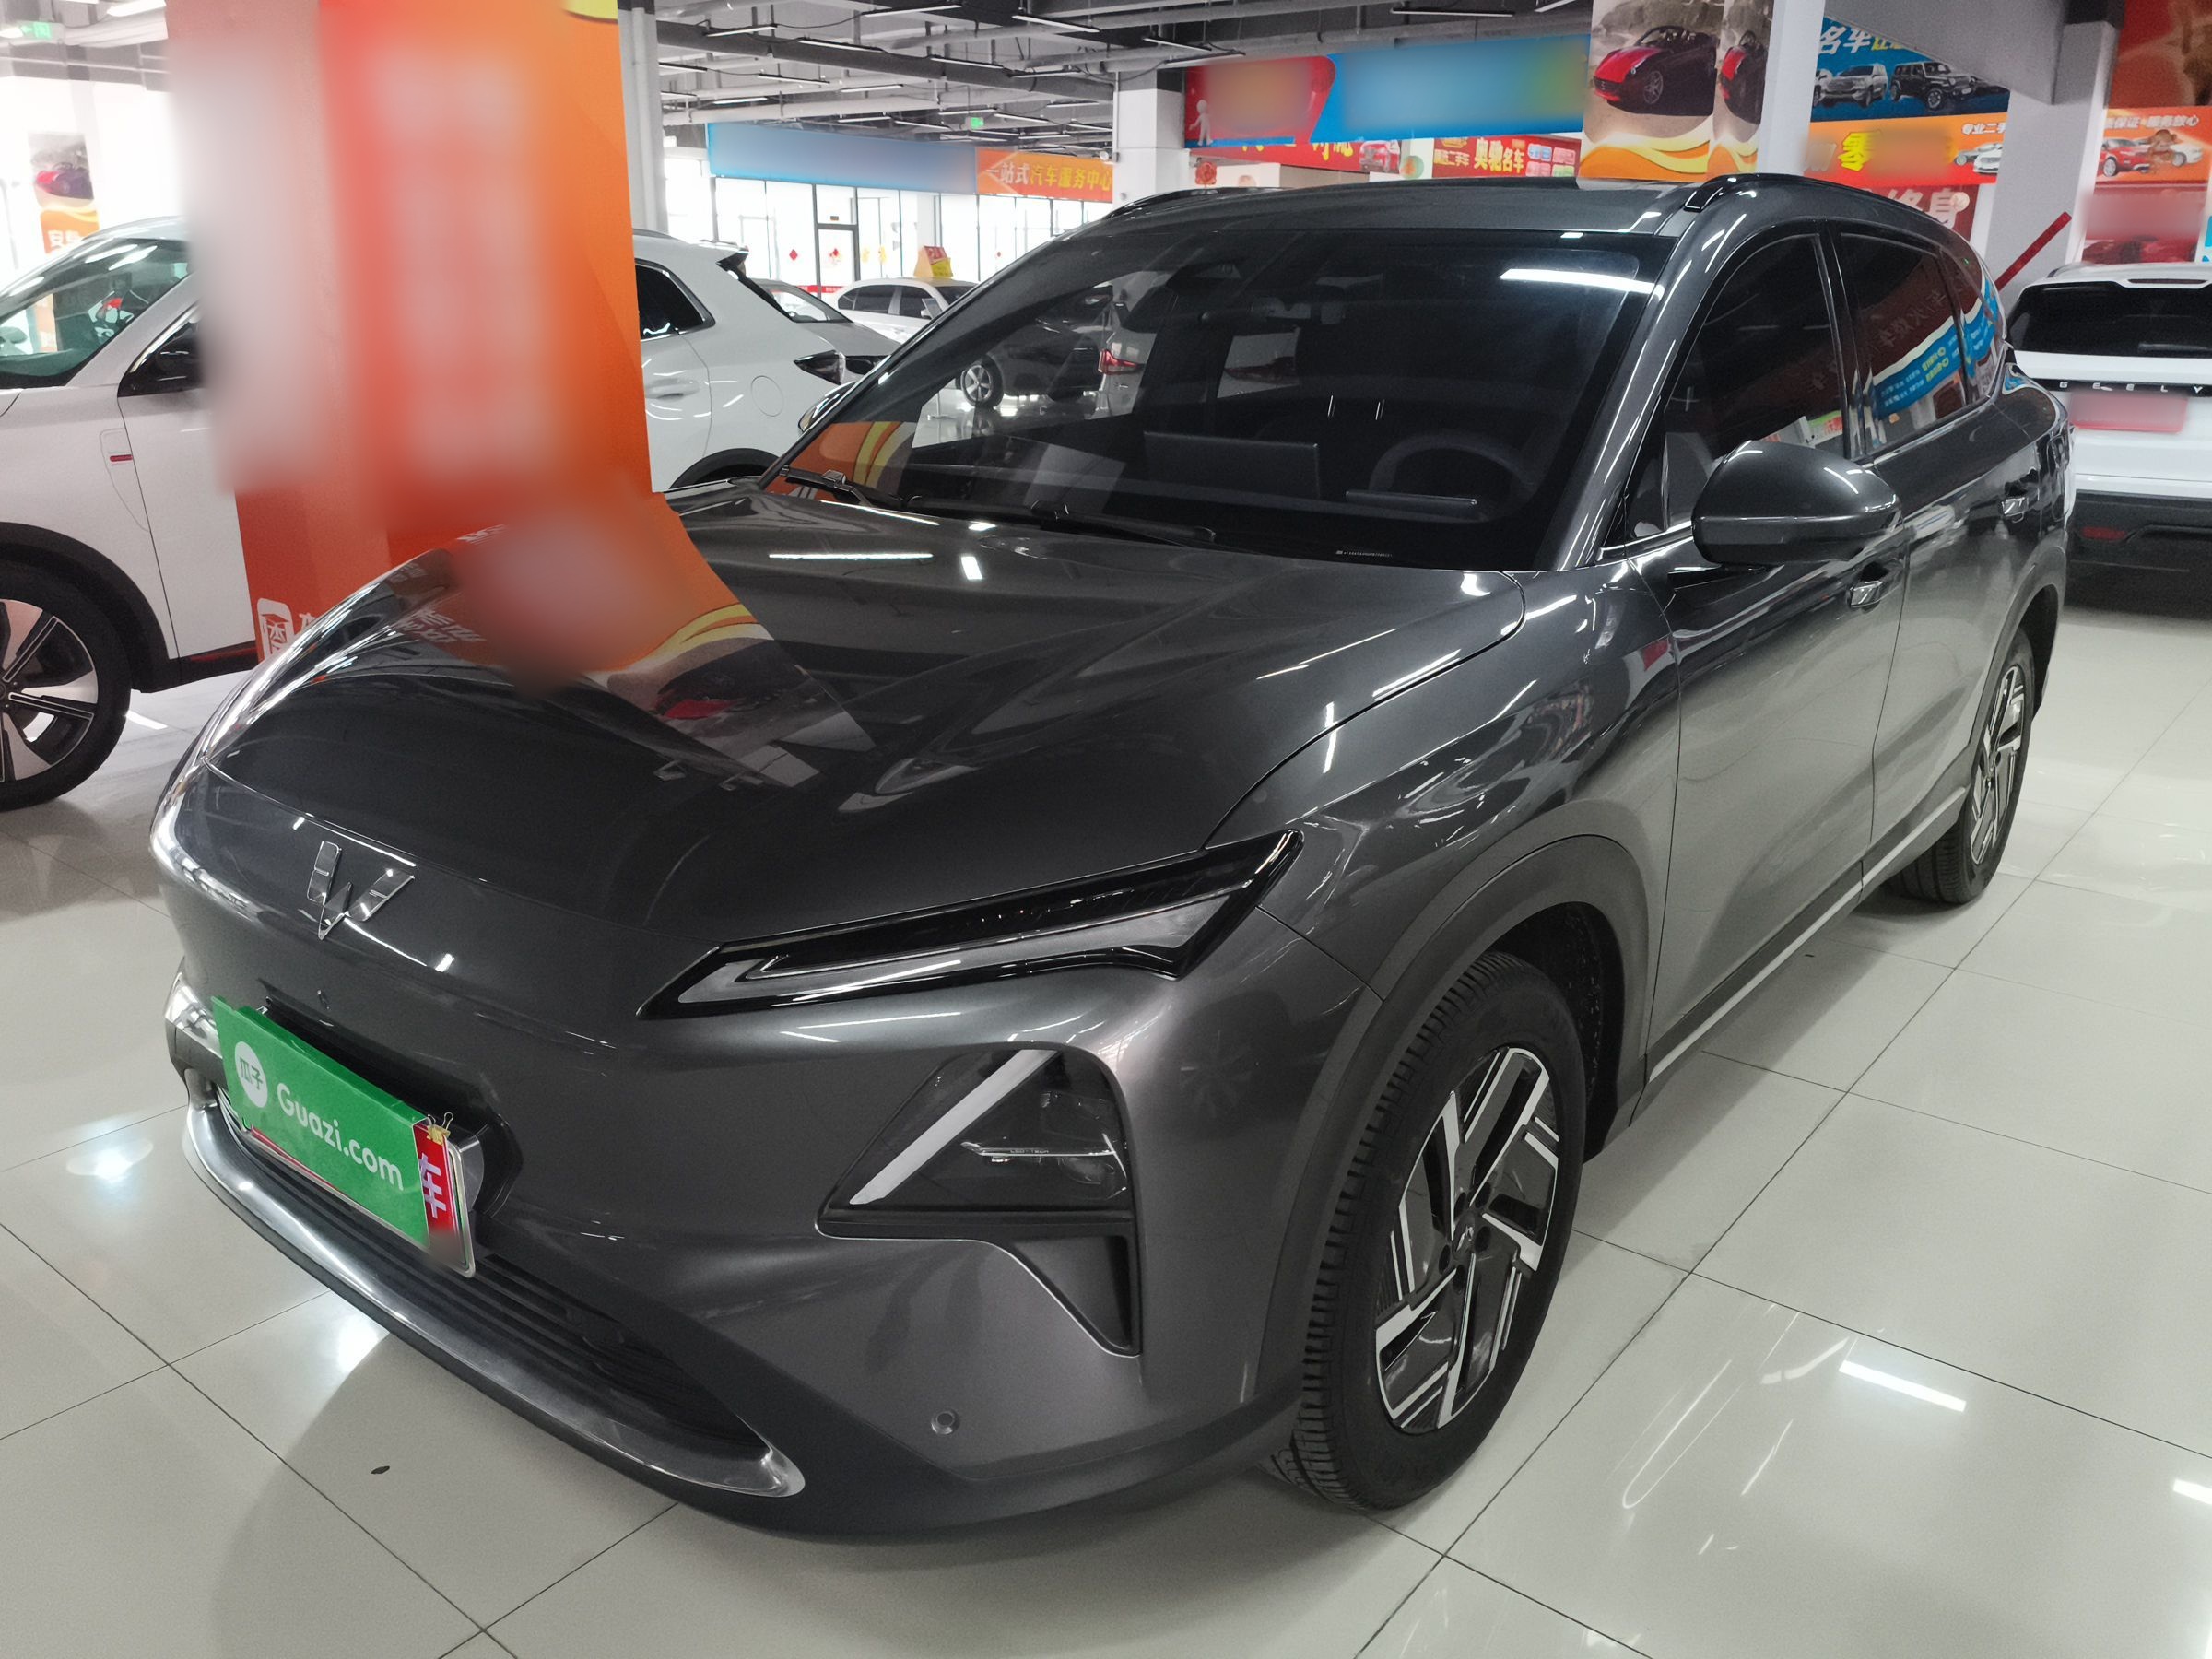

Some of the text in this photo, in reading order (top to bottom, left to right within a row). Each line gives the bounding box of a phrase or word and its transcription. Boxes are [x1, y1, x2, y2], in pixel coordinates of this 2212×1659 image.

[1820, 25, 1902, 55] 名车
[986, 162, 1111, 191] 一站式汽车服务中心
[2059, 381, 2203, 394] GEELY
[240, 1057, 404, 1191] 瓜子 Guazi.com
